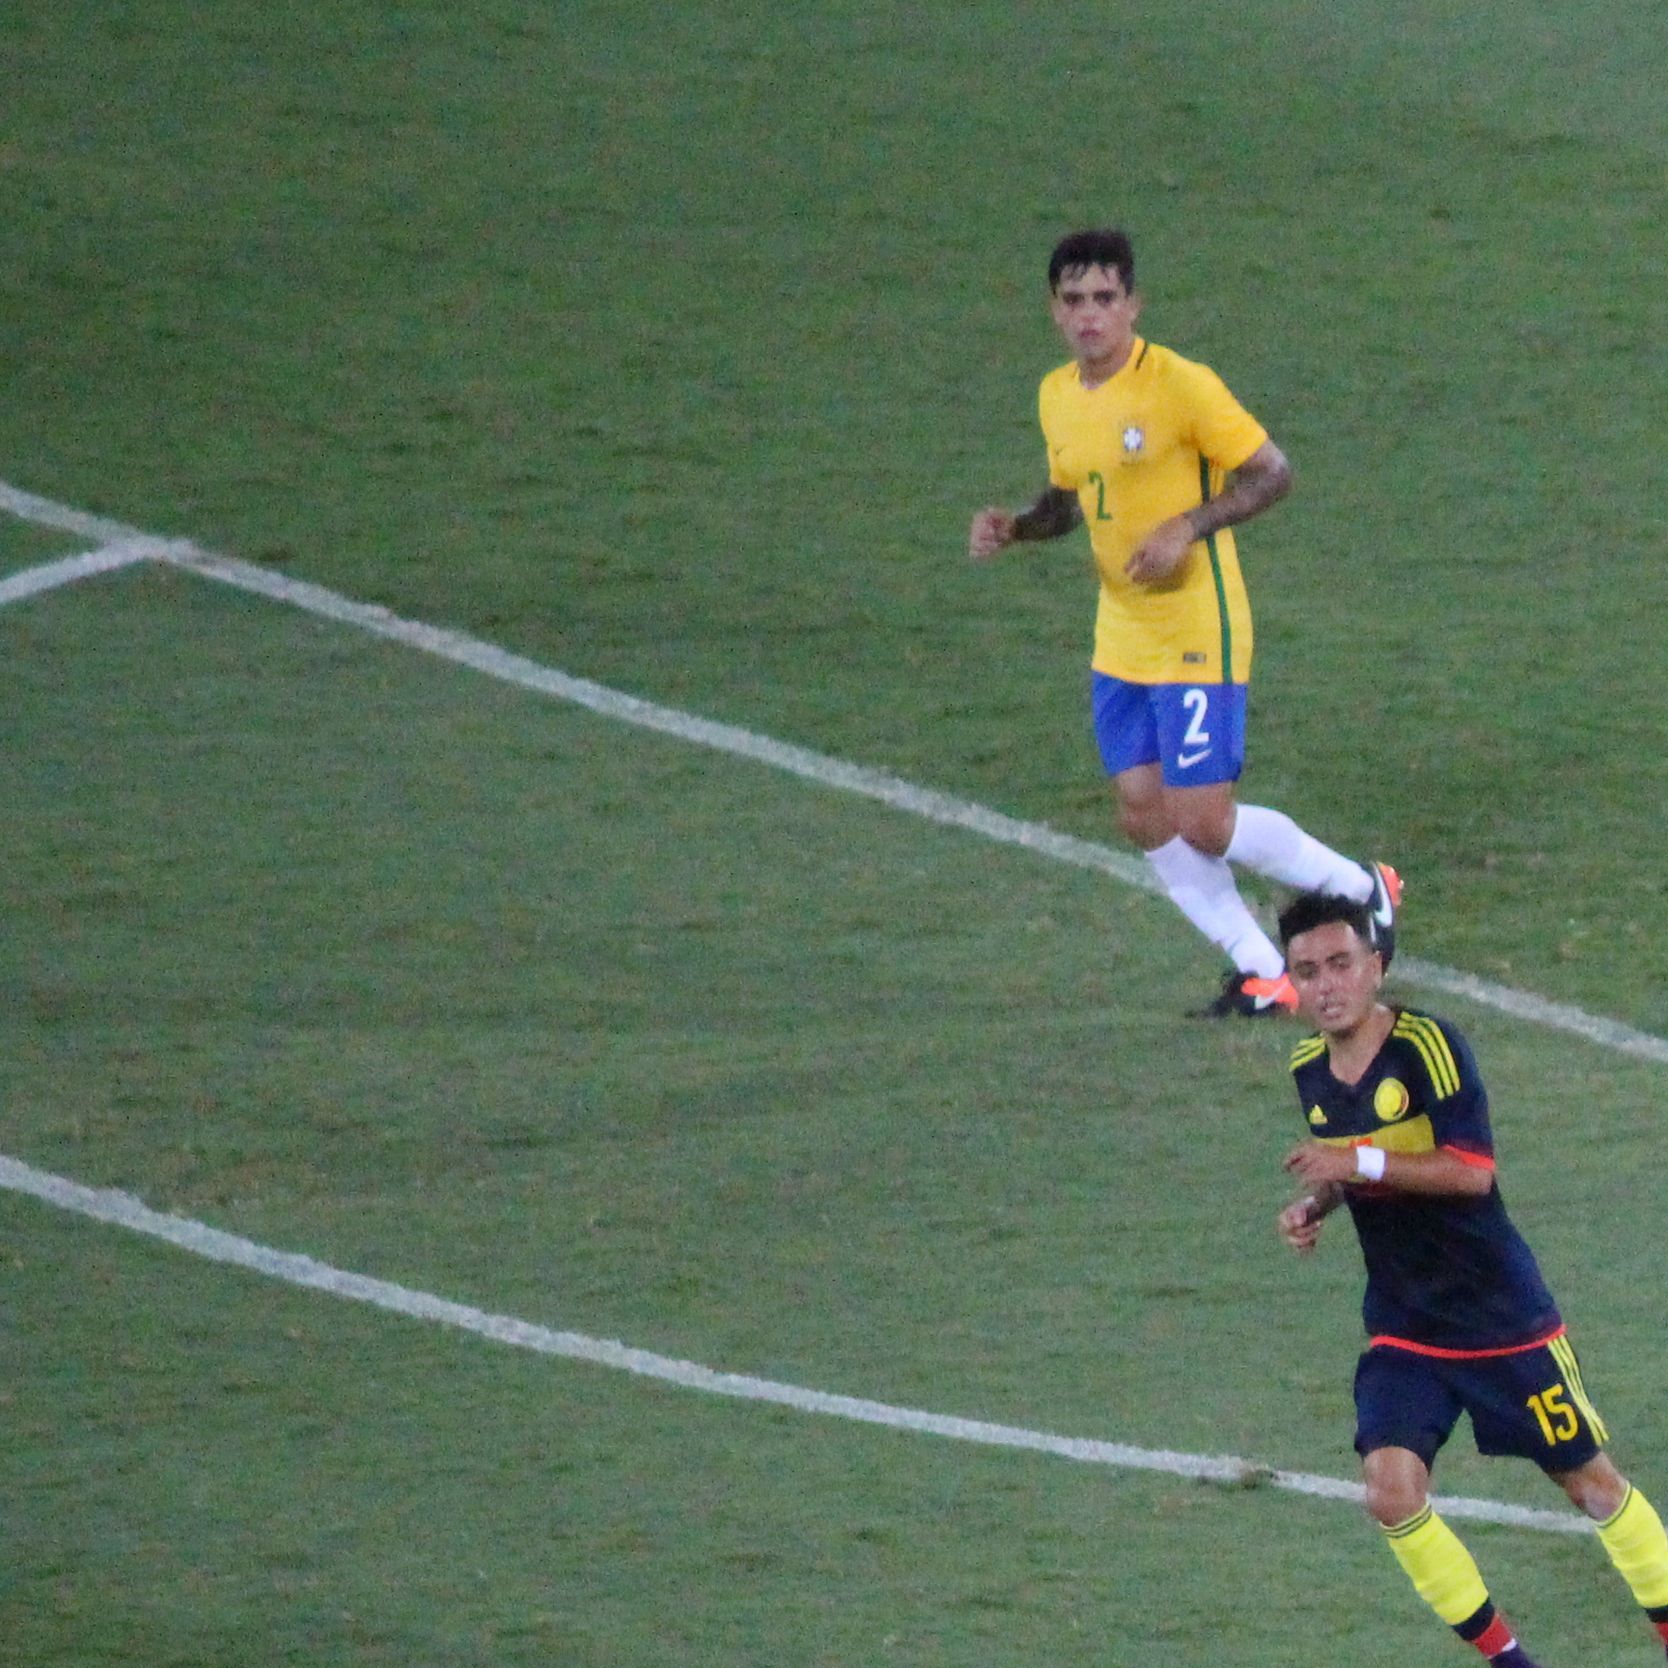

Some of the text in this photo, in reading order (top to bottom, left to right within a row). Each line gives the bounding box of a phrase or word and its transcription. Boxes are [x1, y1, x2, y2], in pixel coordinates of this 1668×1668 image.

[1087, 470, 1113, 520] 2
[1183, 688, 1210, 744] 2
[1526, 1382, 1579, 1447] 15
